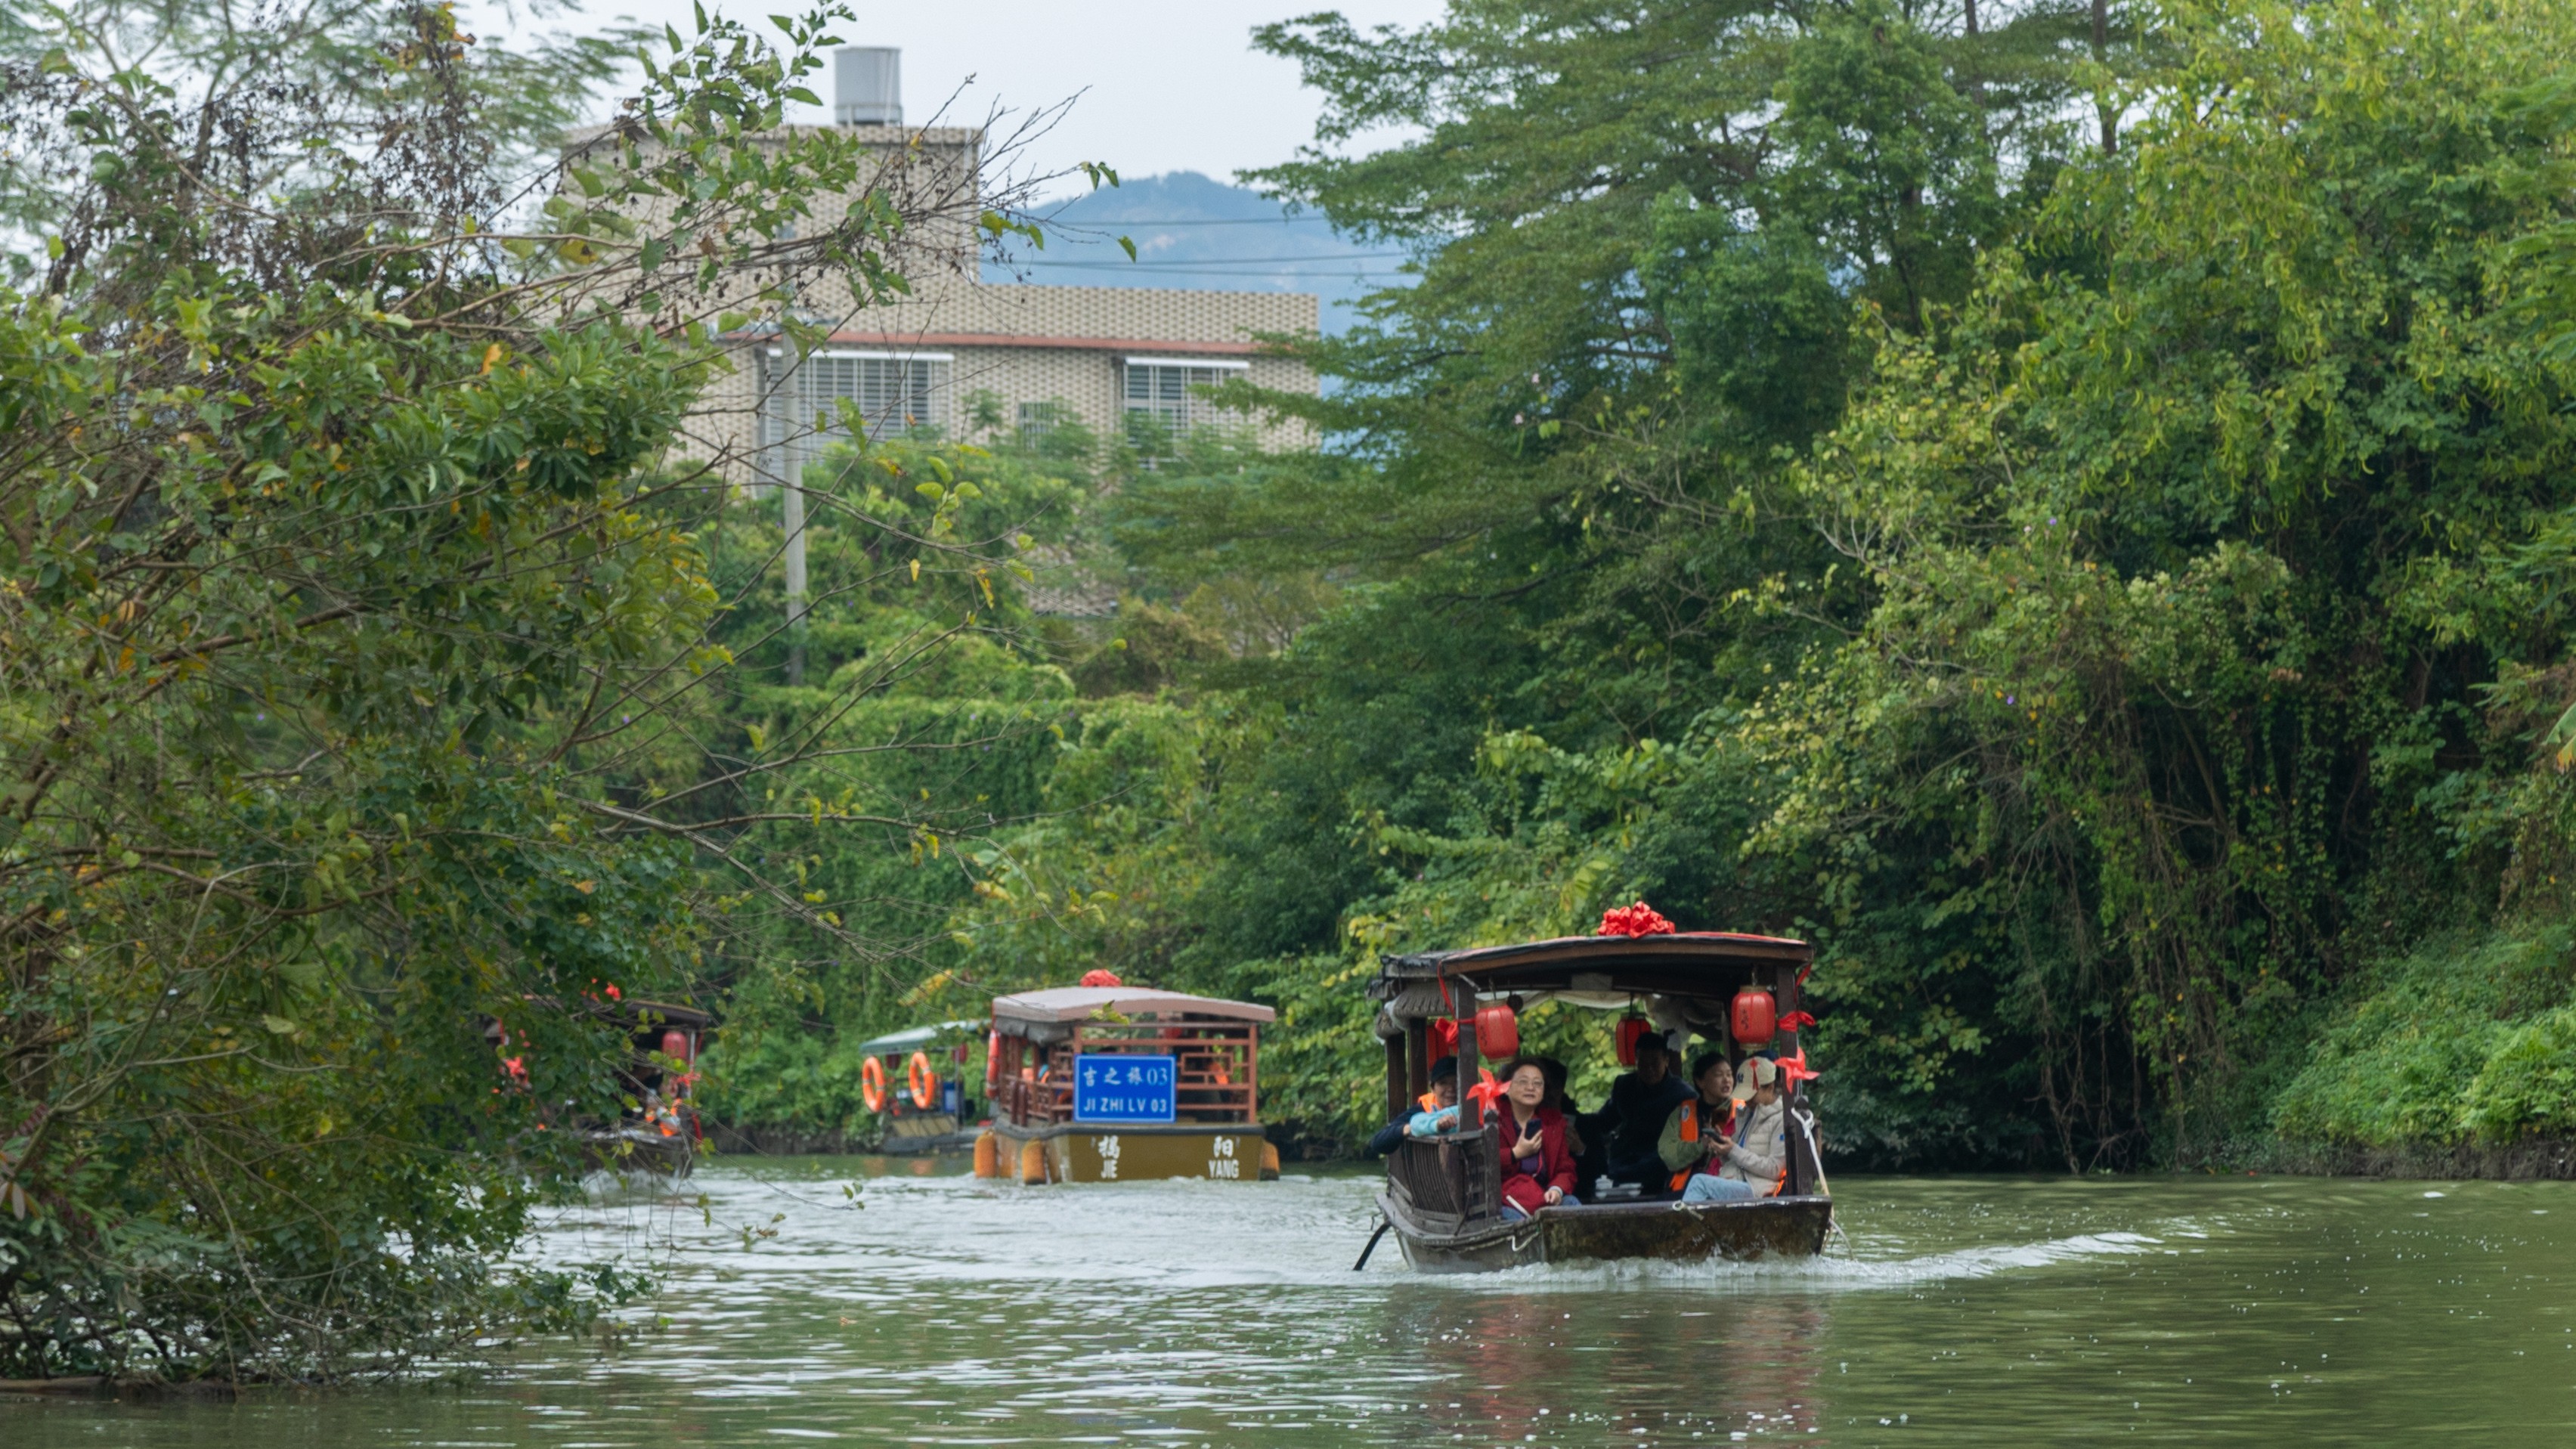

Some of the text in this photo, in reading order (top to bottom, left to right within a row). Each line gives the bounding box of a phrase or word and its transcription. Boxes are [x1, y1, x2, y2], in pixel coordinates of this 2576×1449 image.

[1084, 1097, 1167, 1113] JI ZHI LV 03
[1101, 1160, 1240, 1178] JIE YANG
